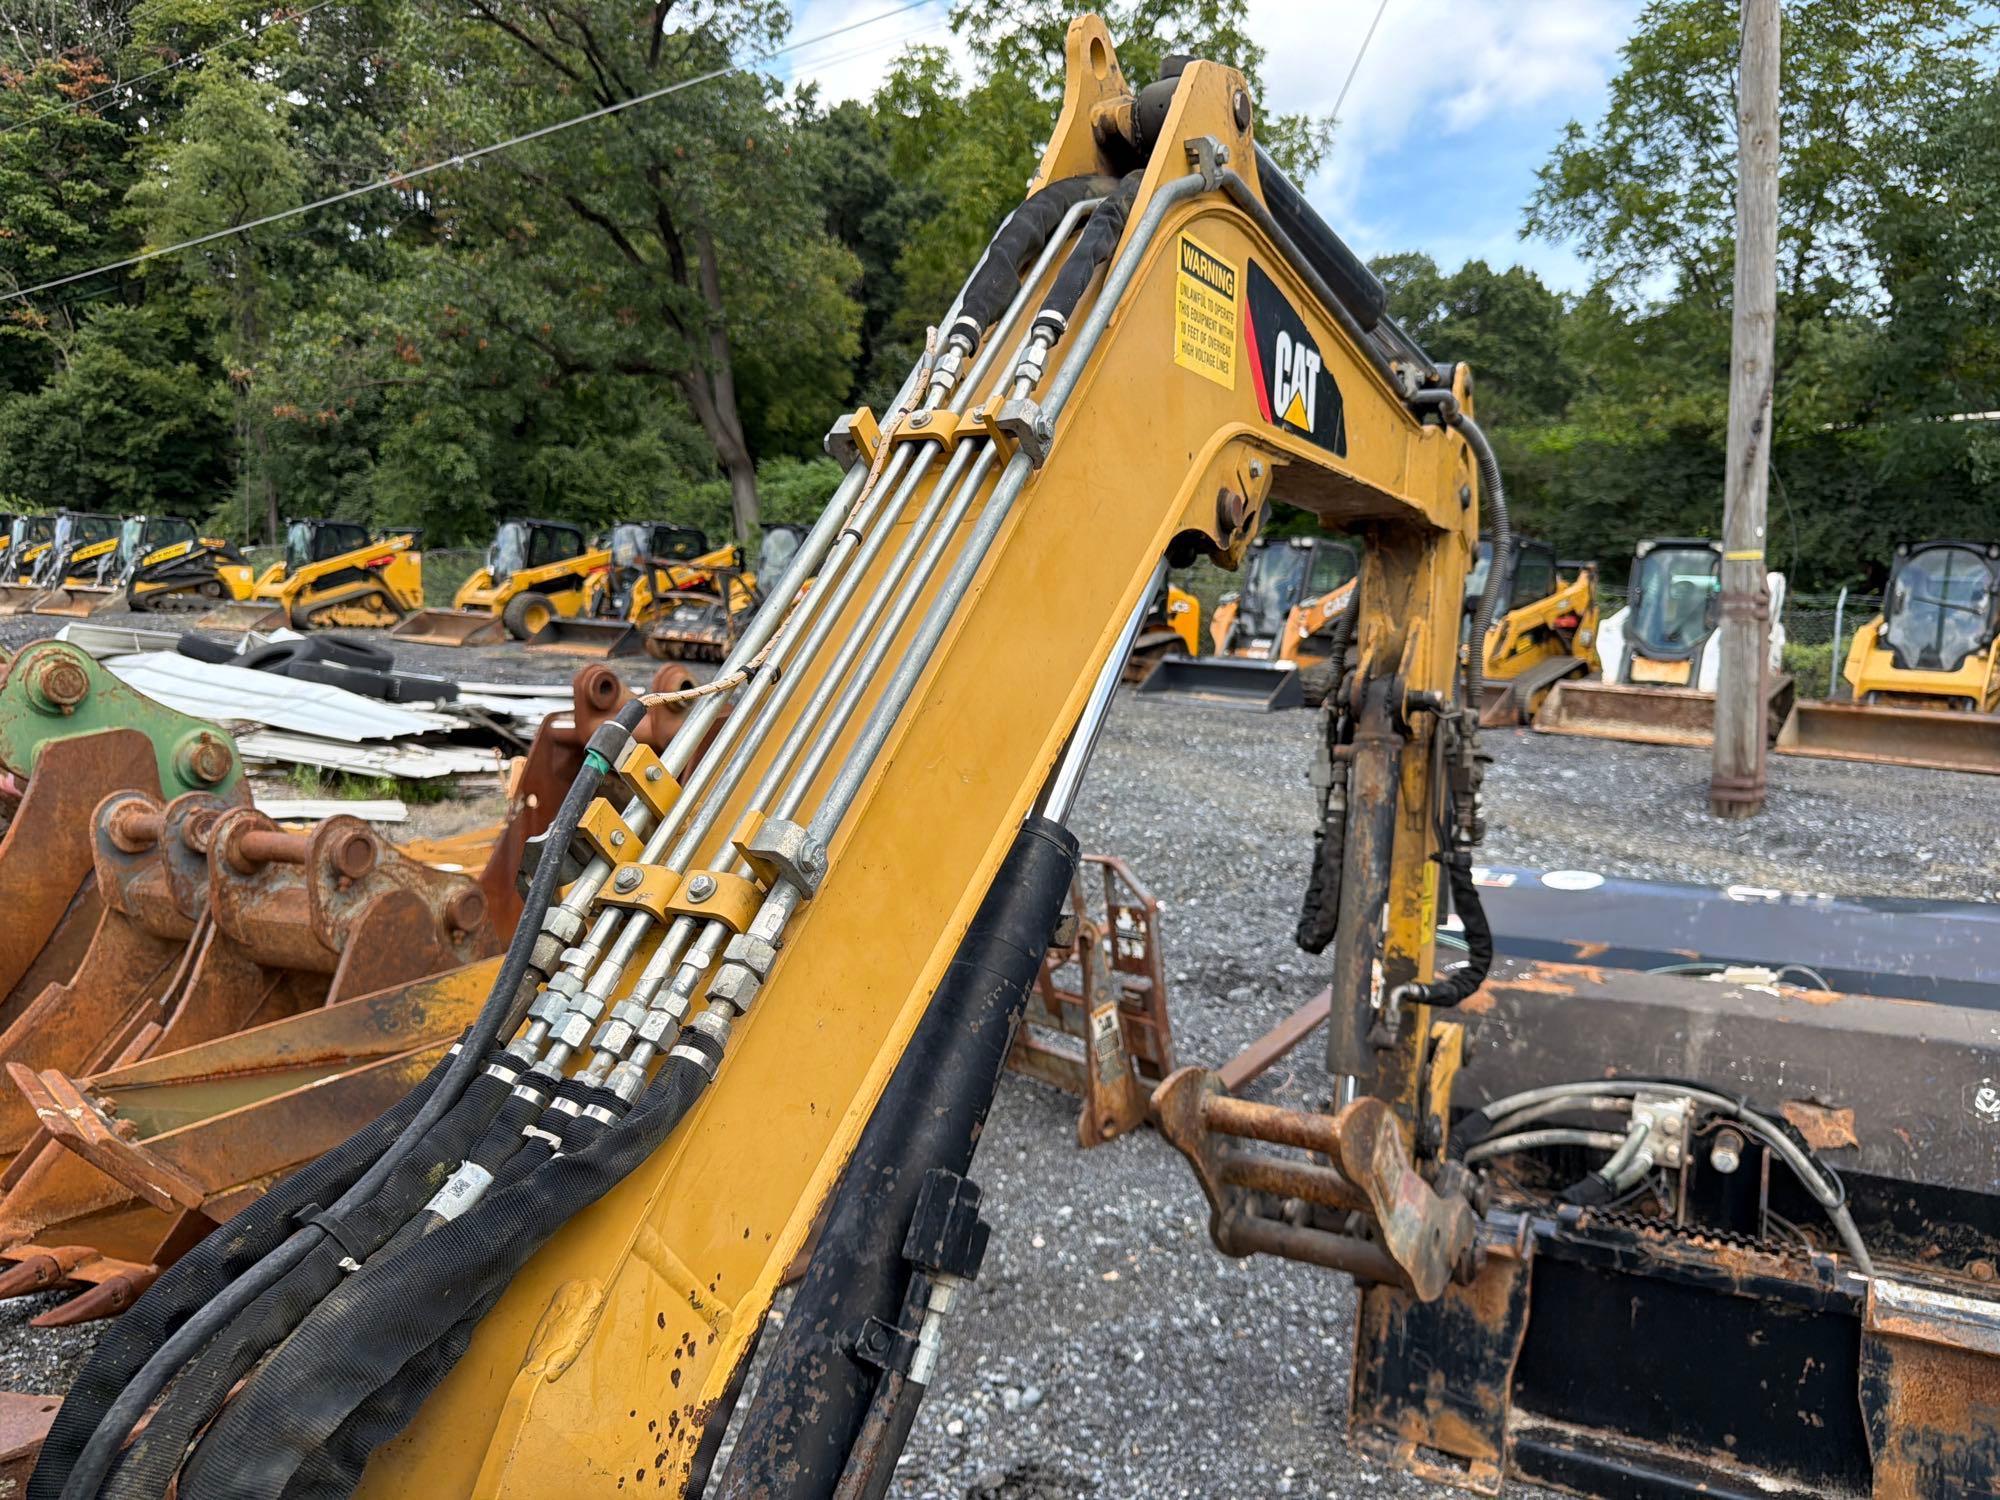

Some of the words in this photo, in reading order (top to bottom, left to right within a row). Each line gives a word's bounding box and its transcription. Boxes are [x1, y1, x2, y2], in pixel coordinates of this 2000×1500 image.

[1183, 243, 1233, 297] WARNING
[1178, 300, 1189, 318] THIS
[1190, 306, 1218, 332] EQUIPMENT
[1180, 282, 1206, 309] UNLAWFUL
[1207, 298, 1214, 312] TO
[1214, 302, 1234, 325] OPERATE
[1181, 321, 1186, 335] 10
[1187, 324, 1199, 341] FEET
[1200, 331, 1207, 345] OF
[1207, 335, 1231, 359] OVERHEAD
[1181, 340, 1194, 357] HIGH
[1195, 346, 1215, 368] VOLTAGE
[1216, 353, 1229, 374] LINES
[1274, 330, 1321, 434] CAT
